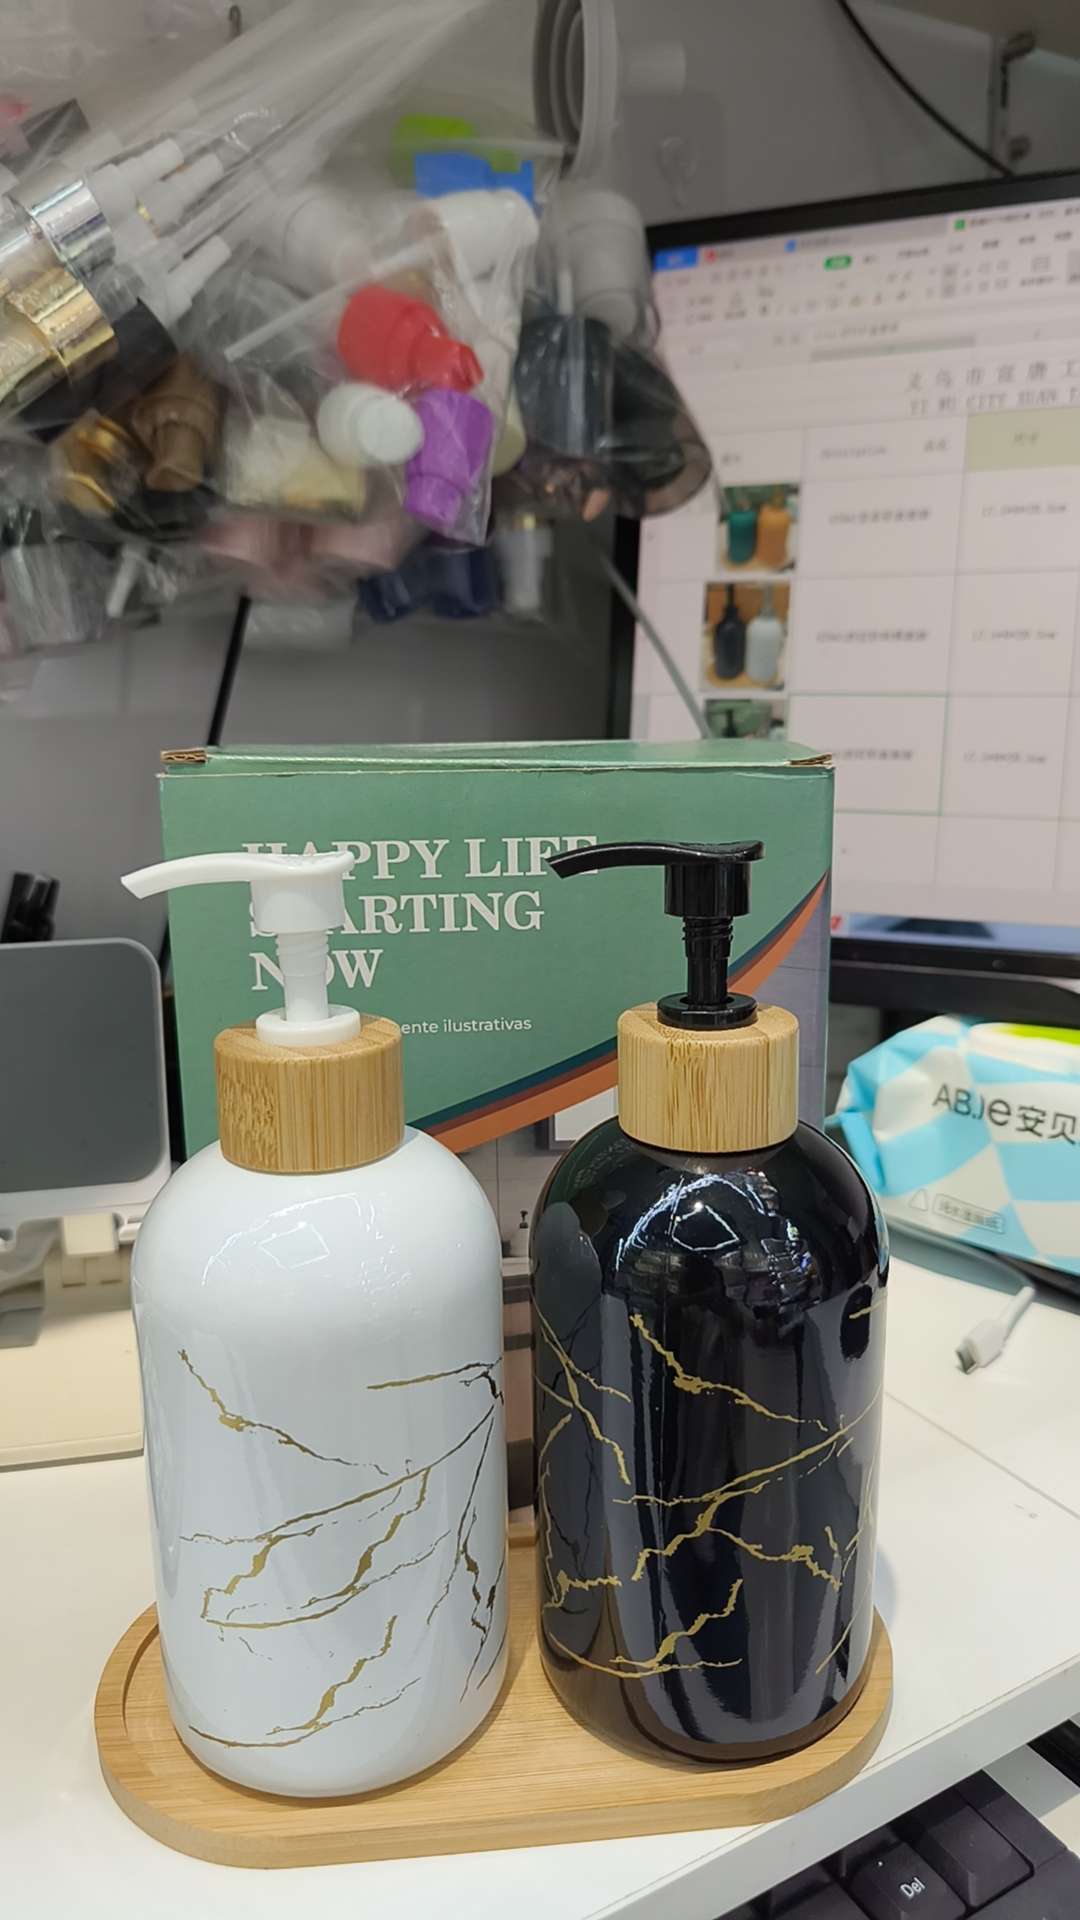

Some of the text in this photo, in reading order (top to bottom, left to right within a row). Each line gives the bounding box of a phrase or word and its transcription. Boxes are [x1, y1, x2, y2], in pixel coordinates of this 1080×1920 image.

[242, 839, 450, 880] PPY
[249, 891, 545, 937] RTING
[249, 949, 384, 990] NW
[443, 1016, 532, 1033] ilustrativas
[900, 1876, 926, 1899] Del
